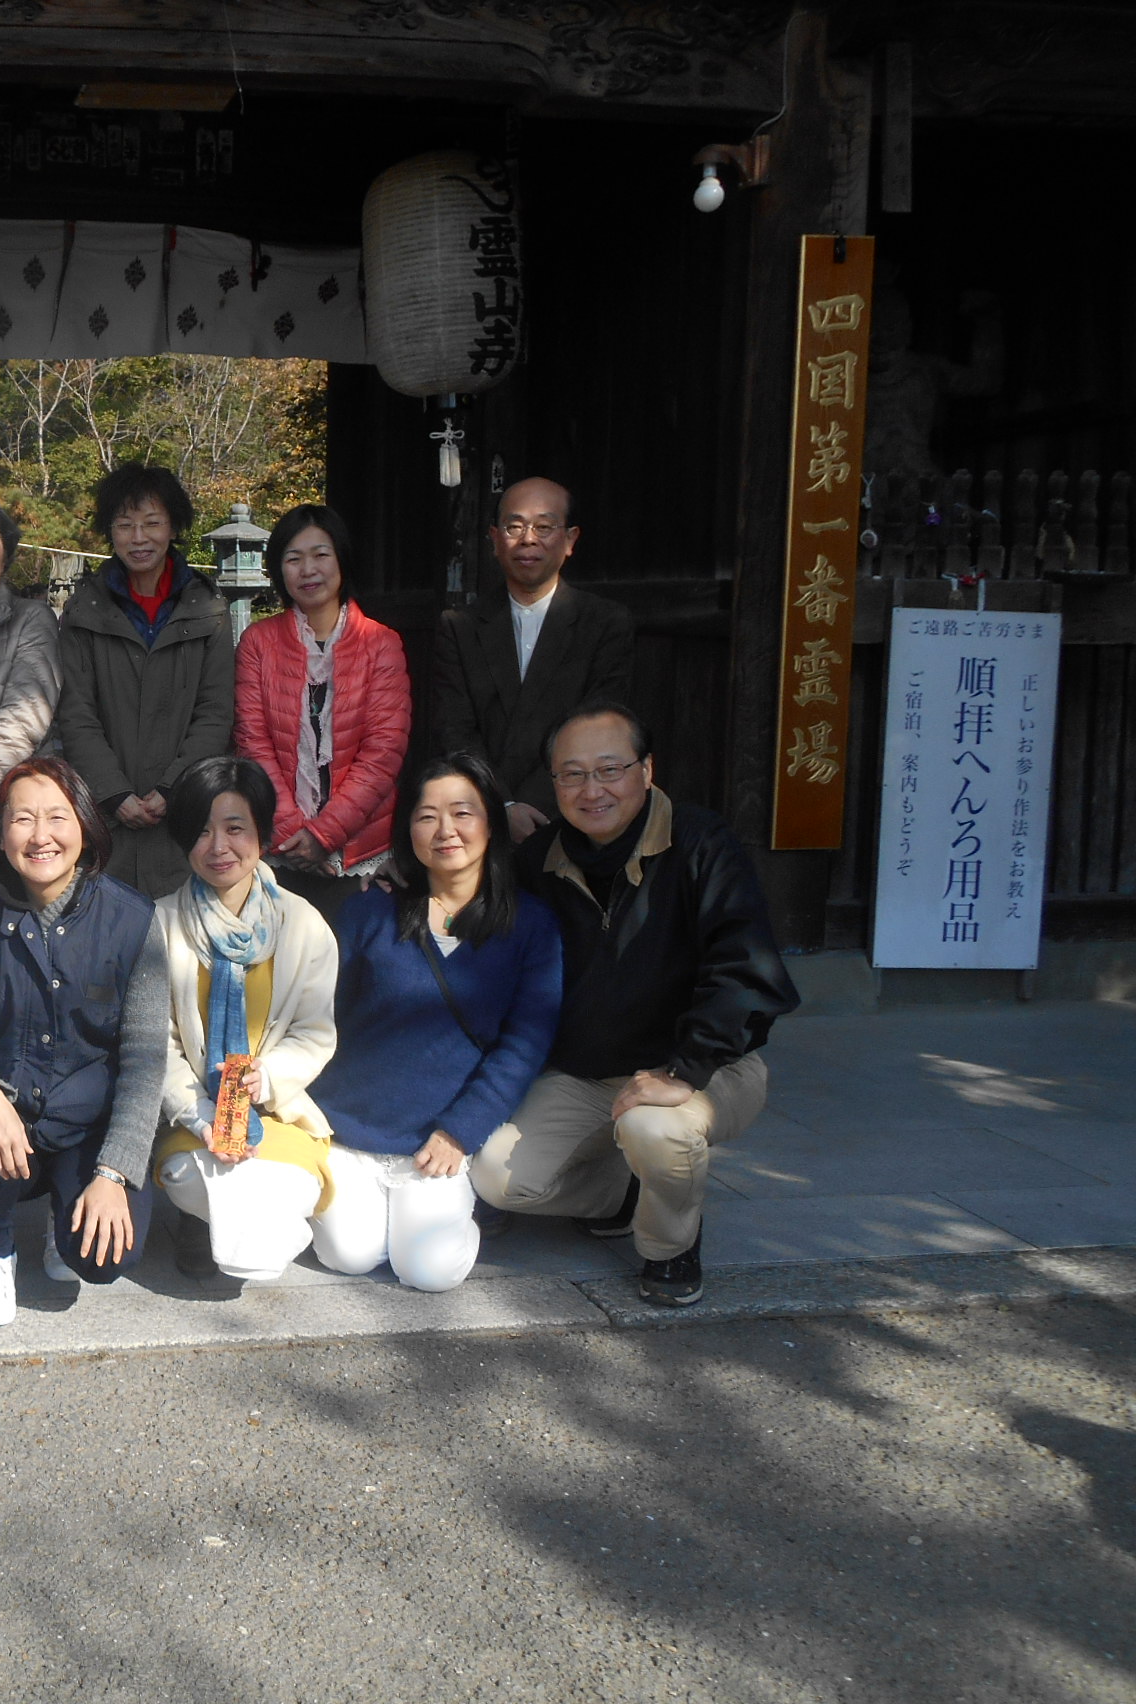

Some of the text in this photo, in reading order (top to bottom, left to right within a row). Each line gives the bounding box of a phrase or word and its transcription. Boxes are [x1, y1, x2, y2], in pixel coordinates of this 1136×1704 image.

[786, 293, 865, 785] 四国第一番霊場
[909, 618, 1044, 639] ご遠路ご苦労さま
[942, 656, 999, 943] 順拝へんろ用品
[1006, 673, 1039, 920] 正しいお参り作法をお教え
